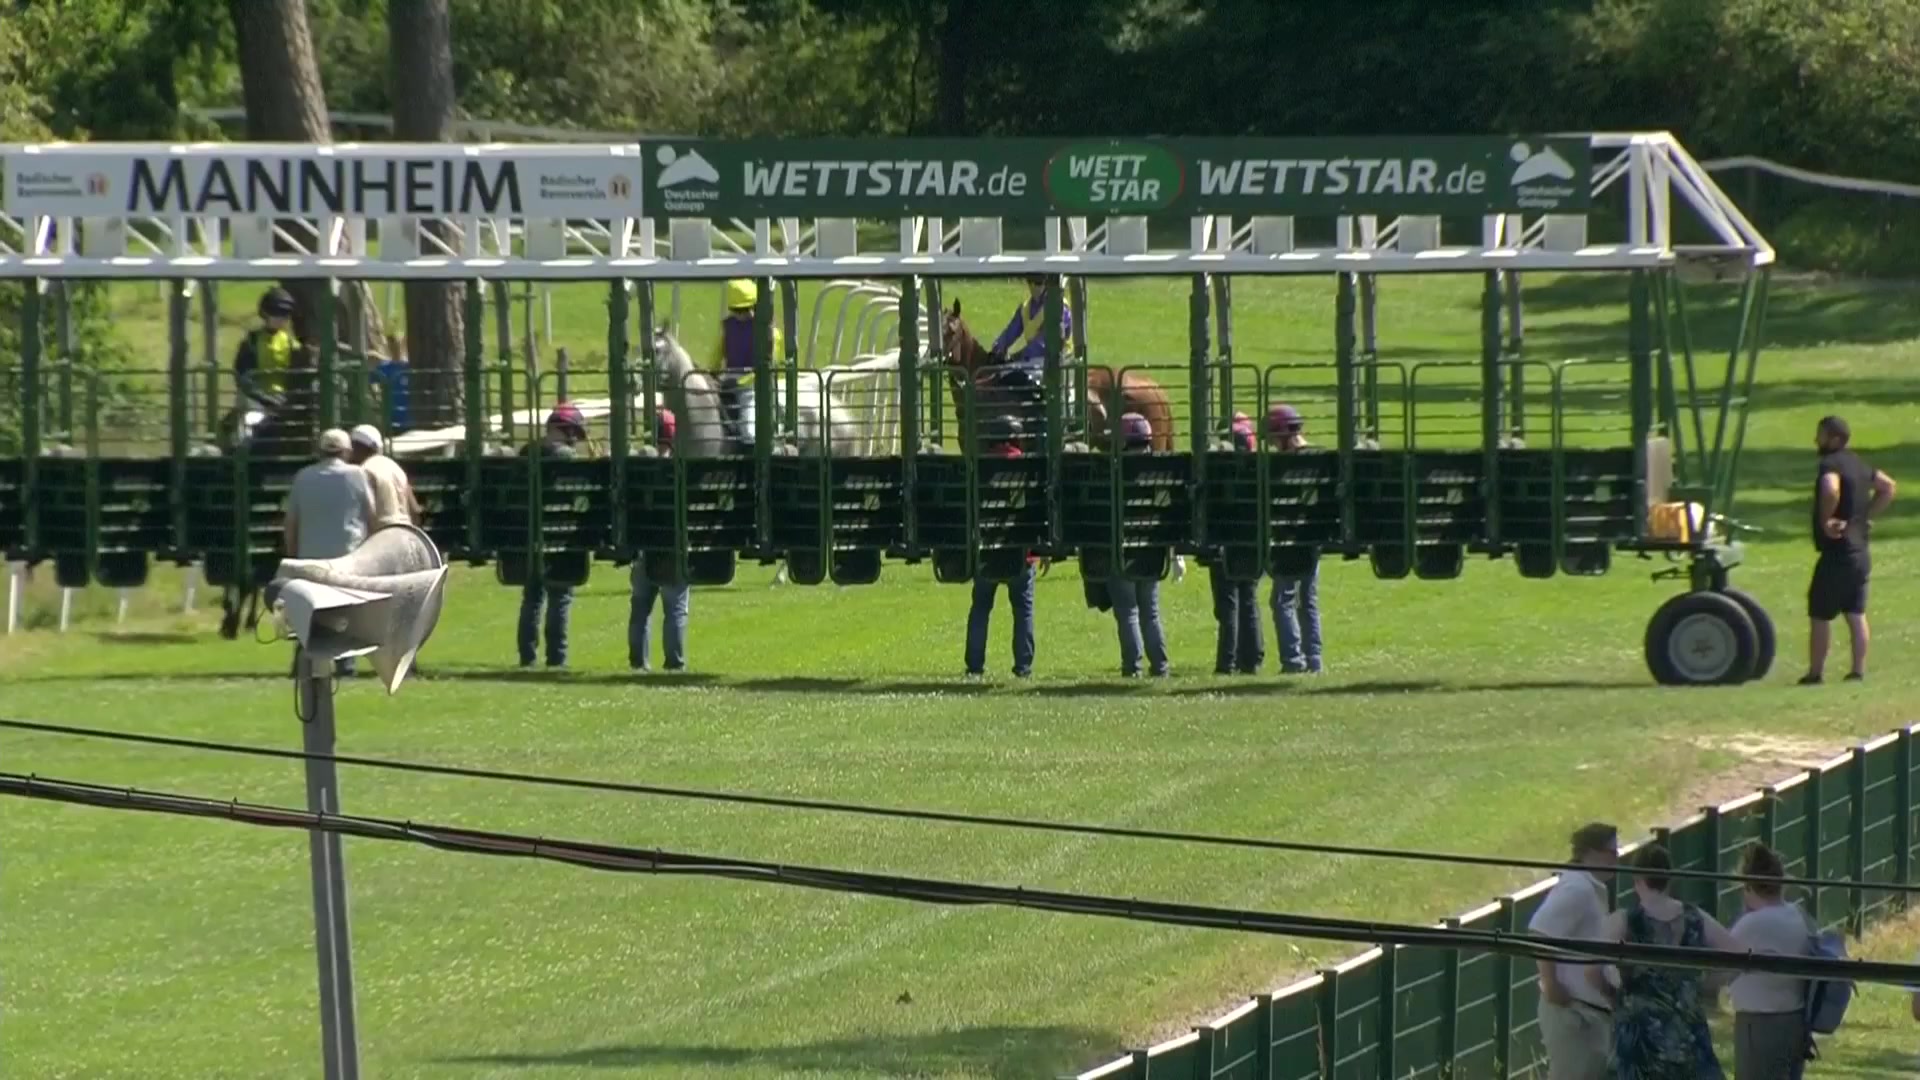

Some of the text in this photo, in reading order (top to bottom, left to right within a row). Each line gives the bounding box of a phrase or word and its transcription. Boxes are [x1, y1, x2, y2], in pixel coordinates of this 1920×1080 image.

[744, 160, 1027, 196] WETTSTAR.de
[1069, 155, 1147, 178] WETT
[1200, 158, 1487, 195] WETTSTAR.de
[128, 158, 522, 213] MANNHEIM
[664, 189, 719, 200] Deutscher
[1089, 179, 1160, 202] STAR
